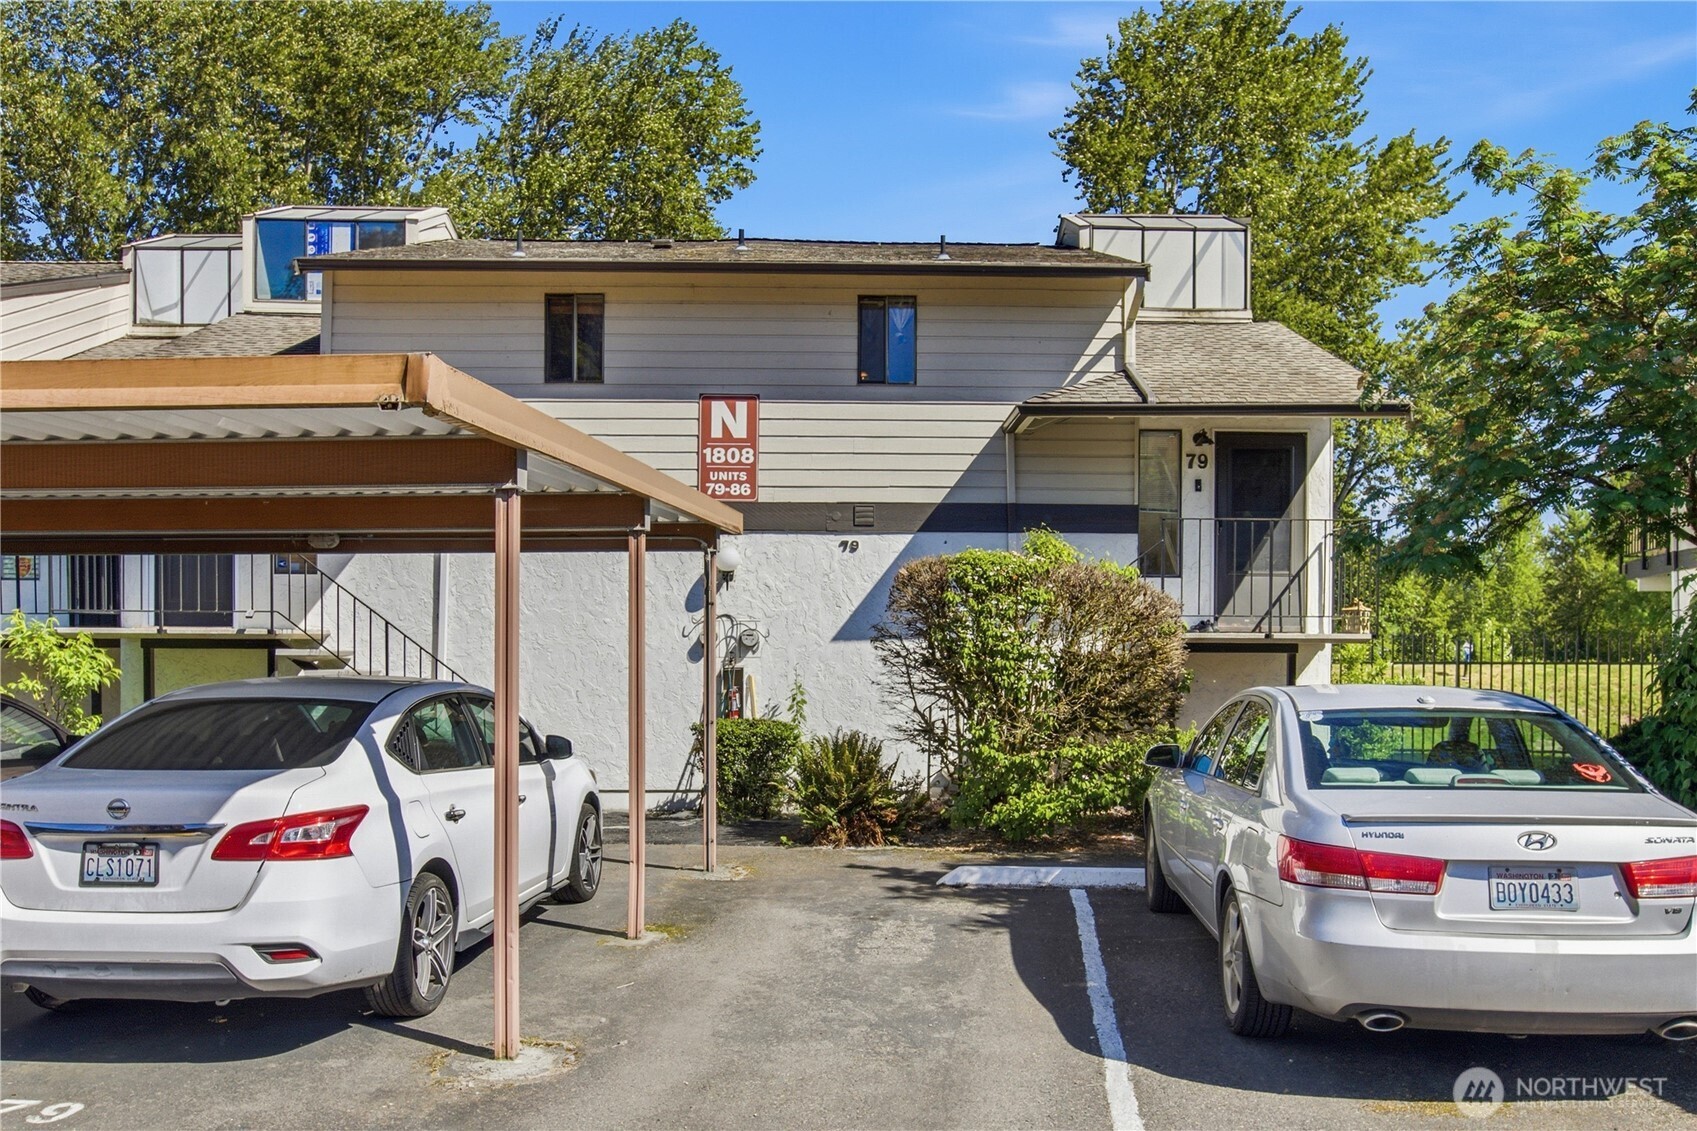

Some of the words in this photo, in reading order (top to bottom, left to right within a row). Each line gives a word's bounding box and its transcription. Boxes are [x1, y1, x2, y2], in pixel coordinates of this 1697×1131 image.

[711, 401, 748, 439] N
[703, 447, 755, 464] 1808
[1186, 453, 1209, 469] 79
[709, 471, 747, 481] UNITS
[705, 483, 751, 496] 79-86
[838, 540, 859, 554] 79
[0, 802, 39, 812] ENTRA
[1361, 831, 1405, 839] HYUNDAI
[1644, 836, 1696, 844] SONATA
[86, 857, 152, 878] CLS1071
[1496, 872, 1545, 880] WASHINGTON
[0, 1099, 85, 1124] 79
